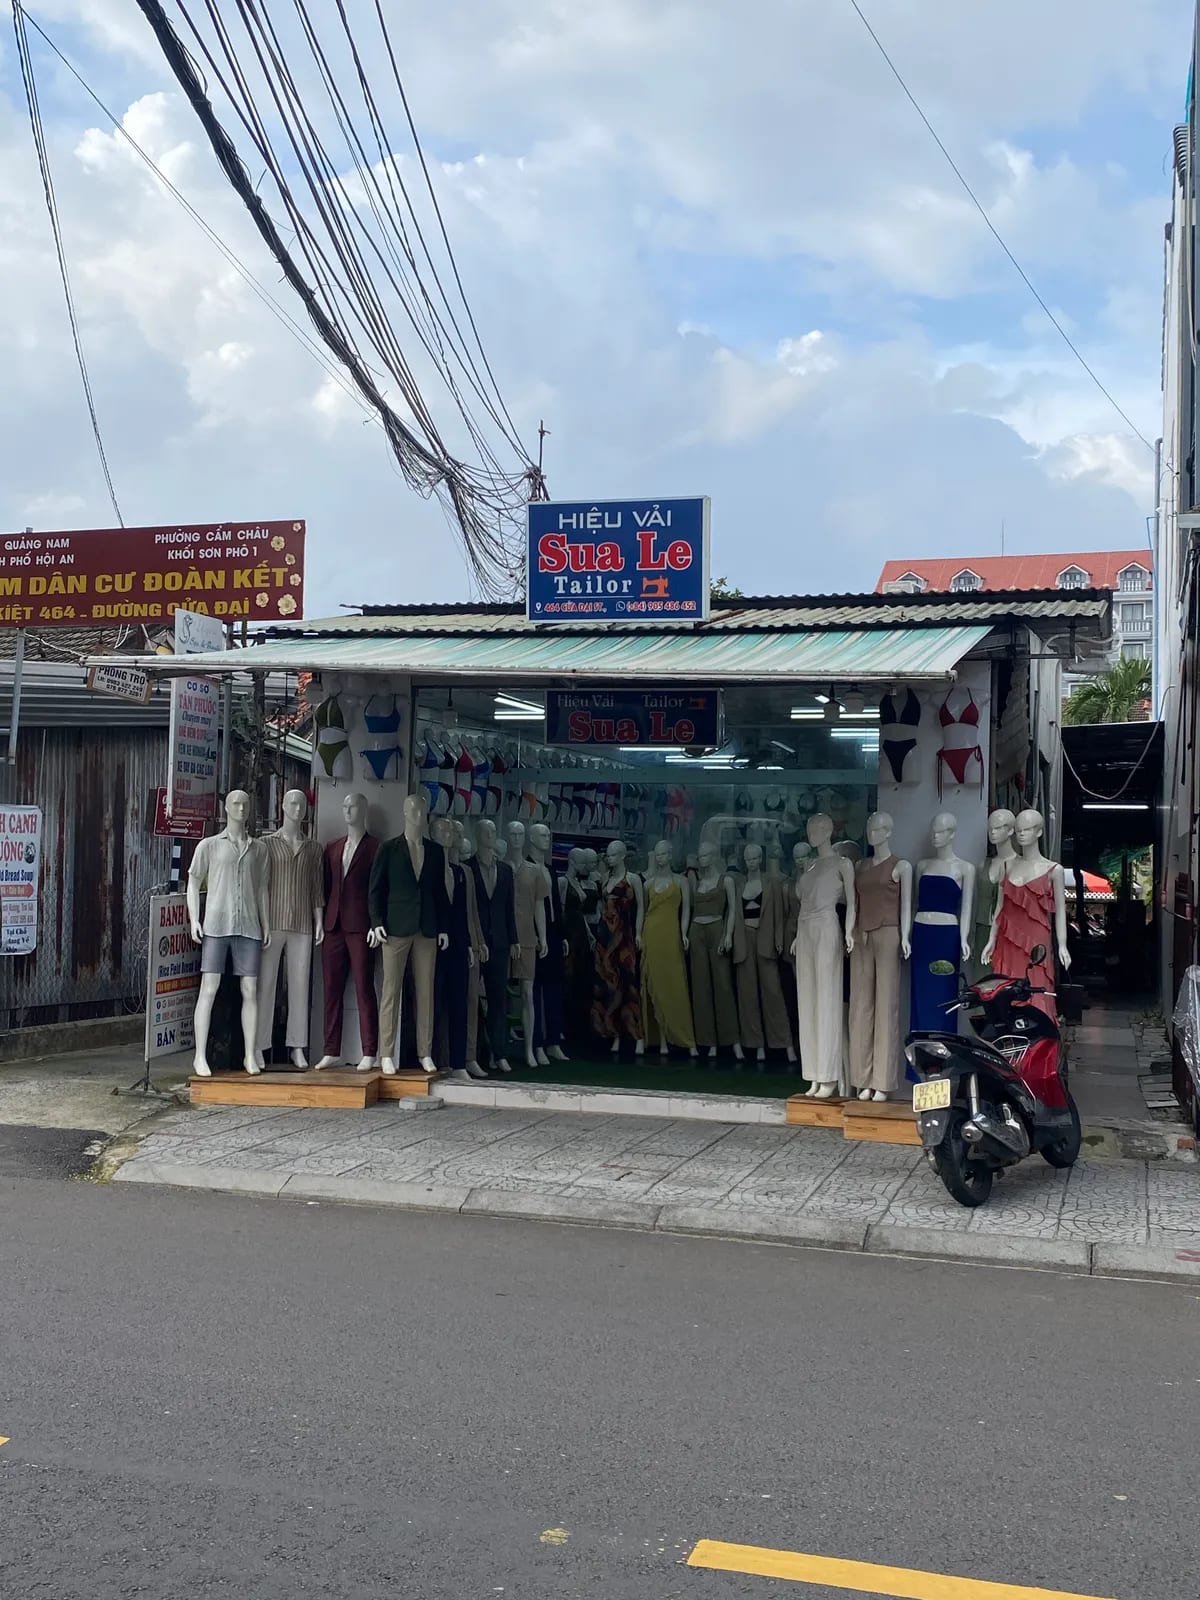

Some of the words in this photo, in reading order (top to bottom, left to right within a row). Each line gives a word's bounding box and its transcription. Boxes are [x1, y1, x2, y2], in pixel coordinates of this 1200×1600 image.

[559, 506, 622, 534] HIỆU
[632, 504, 672, 528] VẢI
[5, 536, 41, 550] QUẢNG
[46, 538, 70, 549] NAM
[237, 526, 269, 541] CHÂU
[10, 551, 32, 566] PHỐ
[36, 552, 55, 567] HỘI
[59, 554, 75, 564] AN
[167, 544, 195, 560] KHỐI
[198, 547, 222, 559] SƠN
[252, 546, 258, 557] 1
[538, 533, 625, 573] Sua
[636, 531, 693, 571] Le
[28, 571, 87, 595] DÂN
[95, 571, 137, 593] CƯ
[143, 566, 226, 592] ĐOÀN
[233, 560, 289, 589] KẾT
[554, 575, 633, 595] Tailor
[39, 605, 76, 620] 464
[92, 599, 162, 618] ĐƯỜNG
[557, 694, 589, 709] Hiệu
[642, 694, 685, 708] Tailor
[568, 710, 639, 743] Sua
[649, 711, 695, 743] Le
[9, 814, 38, 834] CANH
[160, 899, 185, 927] BÁNH
[157, 1026, 176, 1047] BÁN
